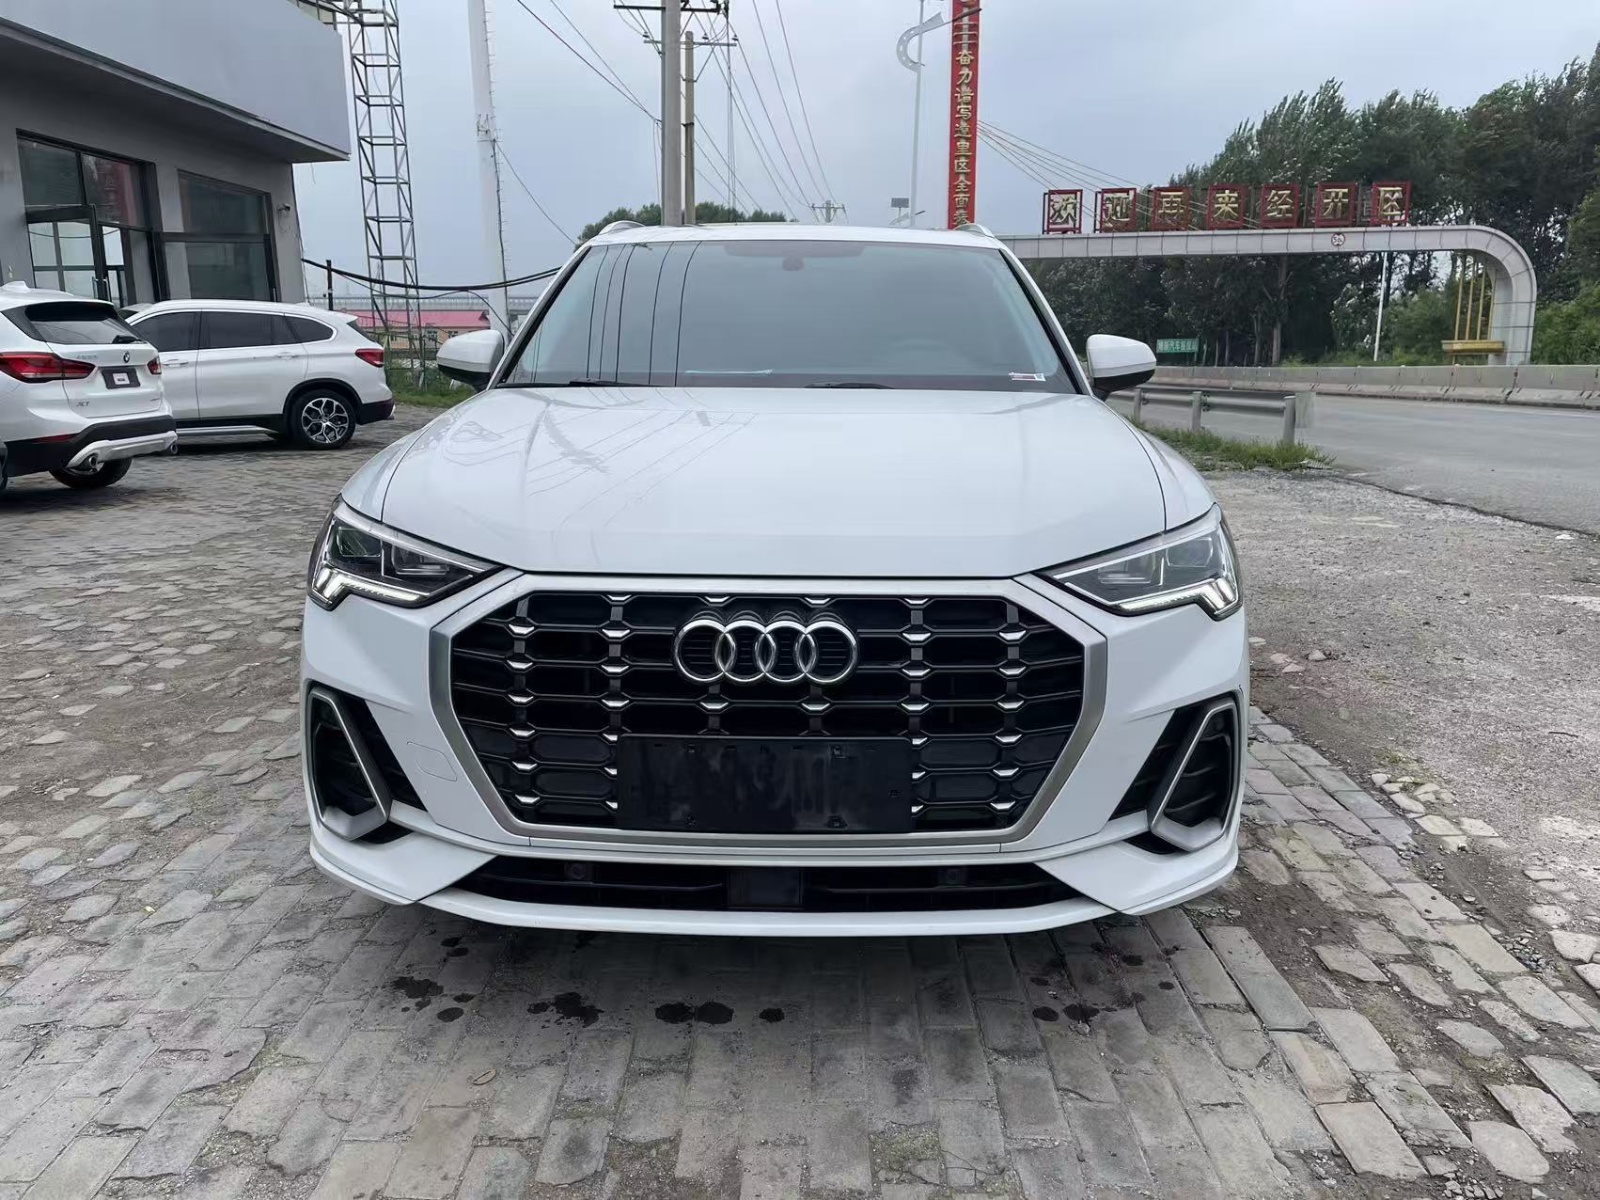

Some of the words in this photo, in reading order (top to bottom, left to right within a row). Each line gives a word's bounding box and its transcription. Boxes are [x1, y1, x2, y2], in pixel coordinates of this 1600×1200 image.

[1049, 187, 1404, 223] 欢迎再来经开区
